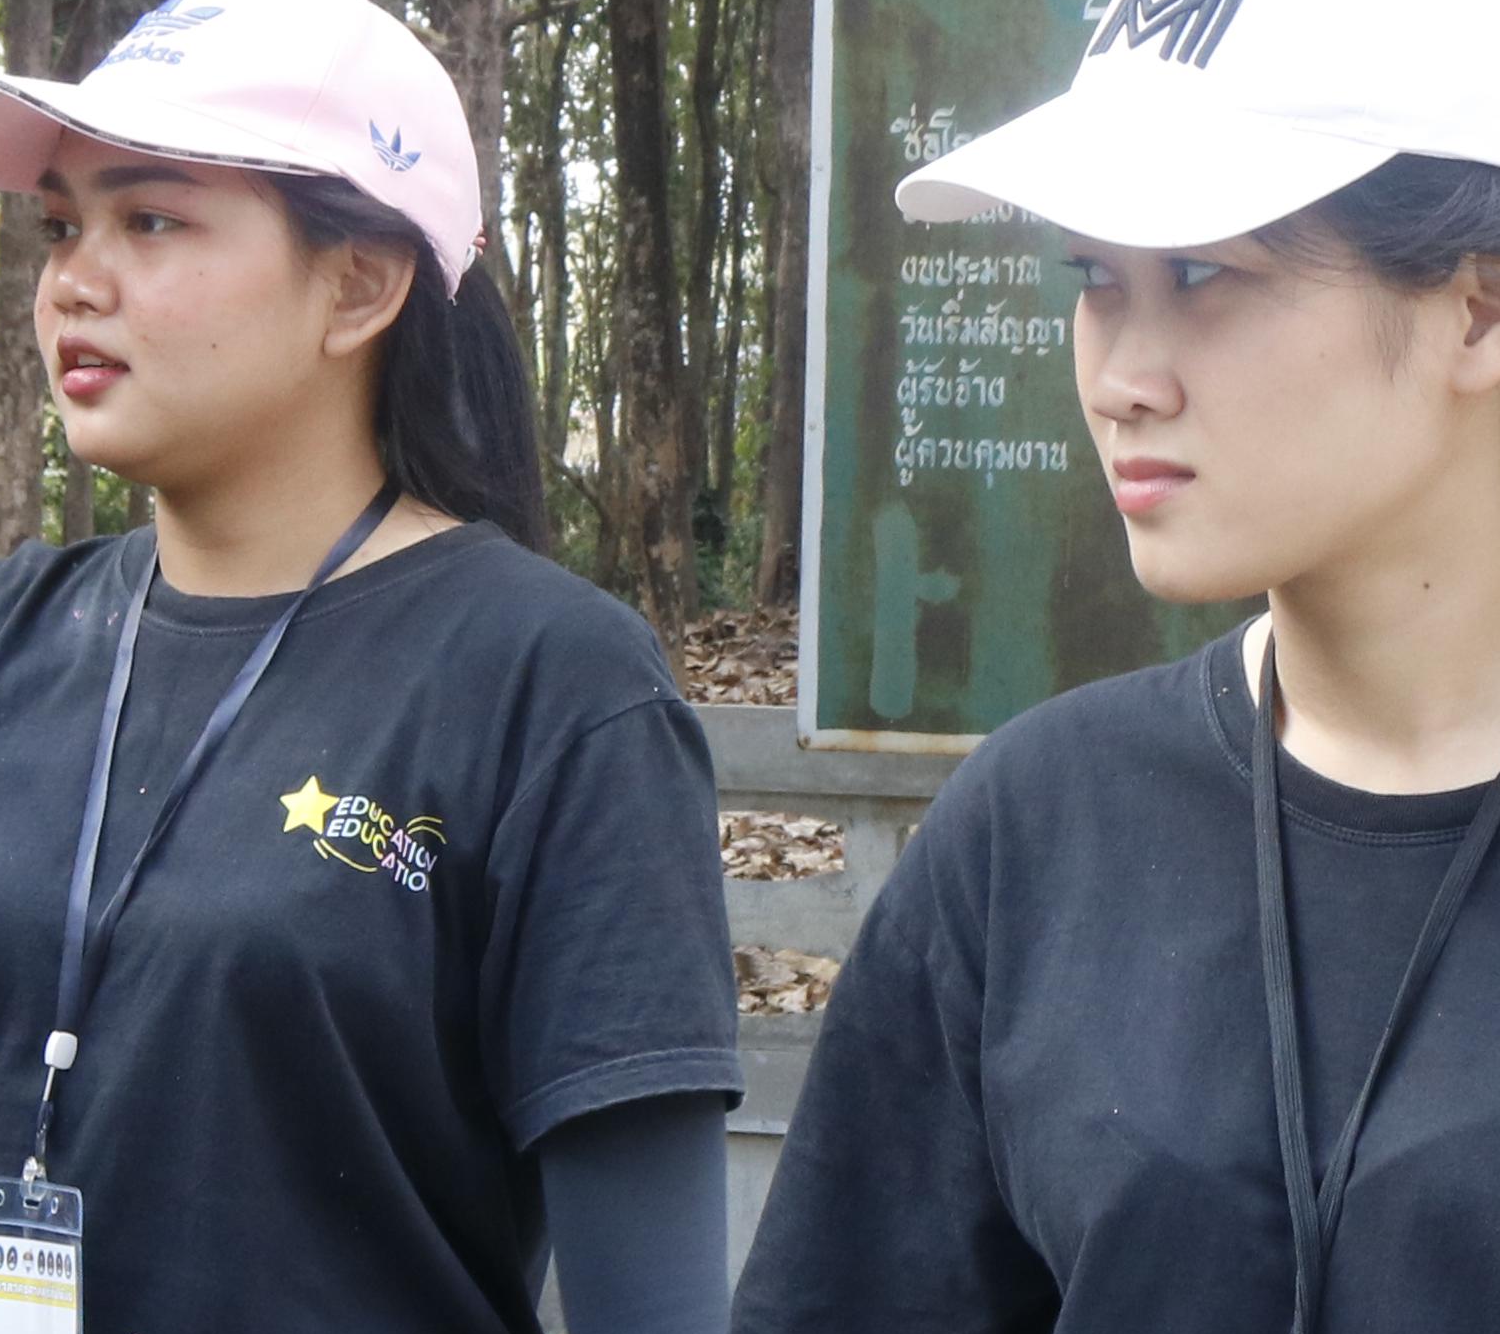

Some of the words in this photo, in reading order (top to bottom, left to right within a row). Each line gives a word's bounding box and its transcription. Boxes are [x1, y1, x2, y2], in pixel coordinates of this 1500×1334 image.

[901, 250, 1042, 287] งบประมาณ
[900, 288, 1066, 356] วันเริ่มสัญญา
[896, 356, 1006, 424] ผู้รับจ้าง
[894, 420, 1069, 490] ผู้ควบคุมงาน
[325, 817, 431, 892] EDUCATIO
